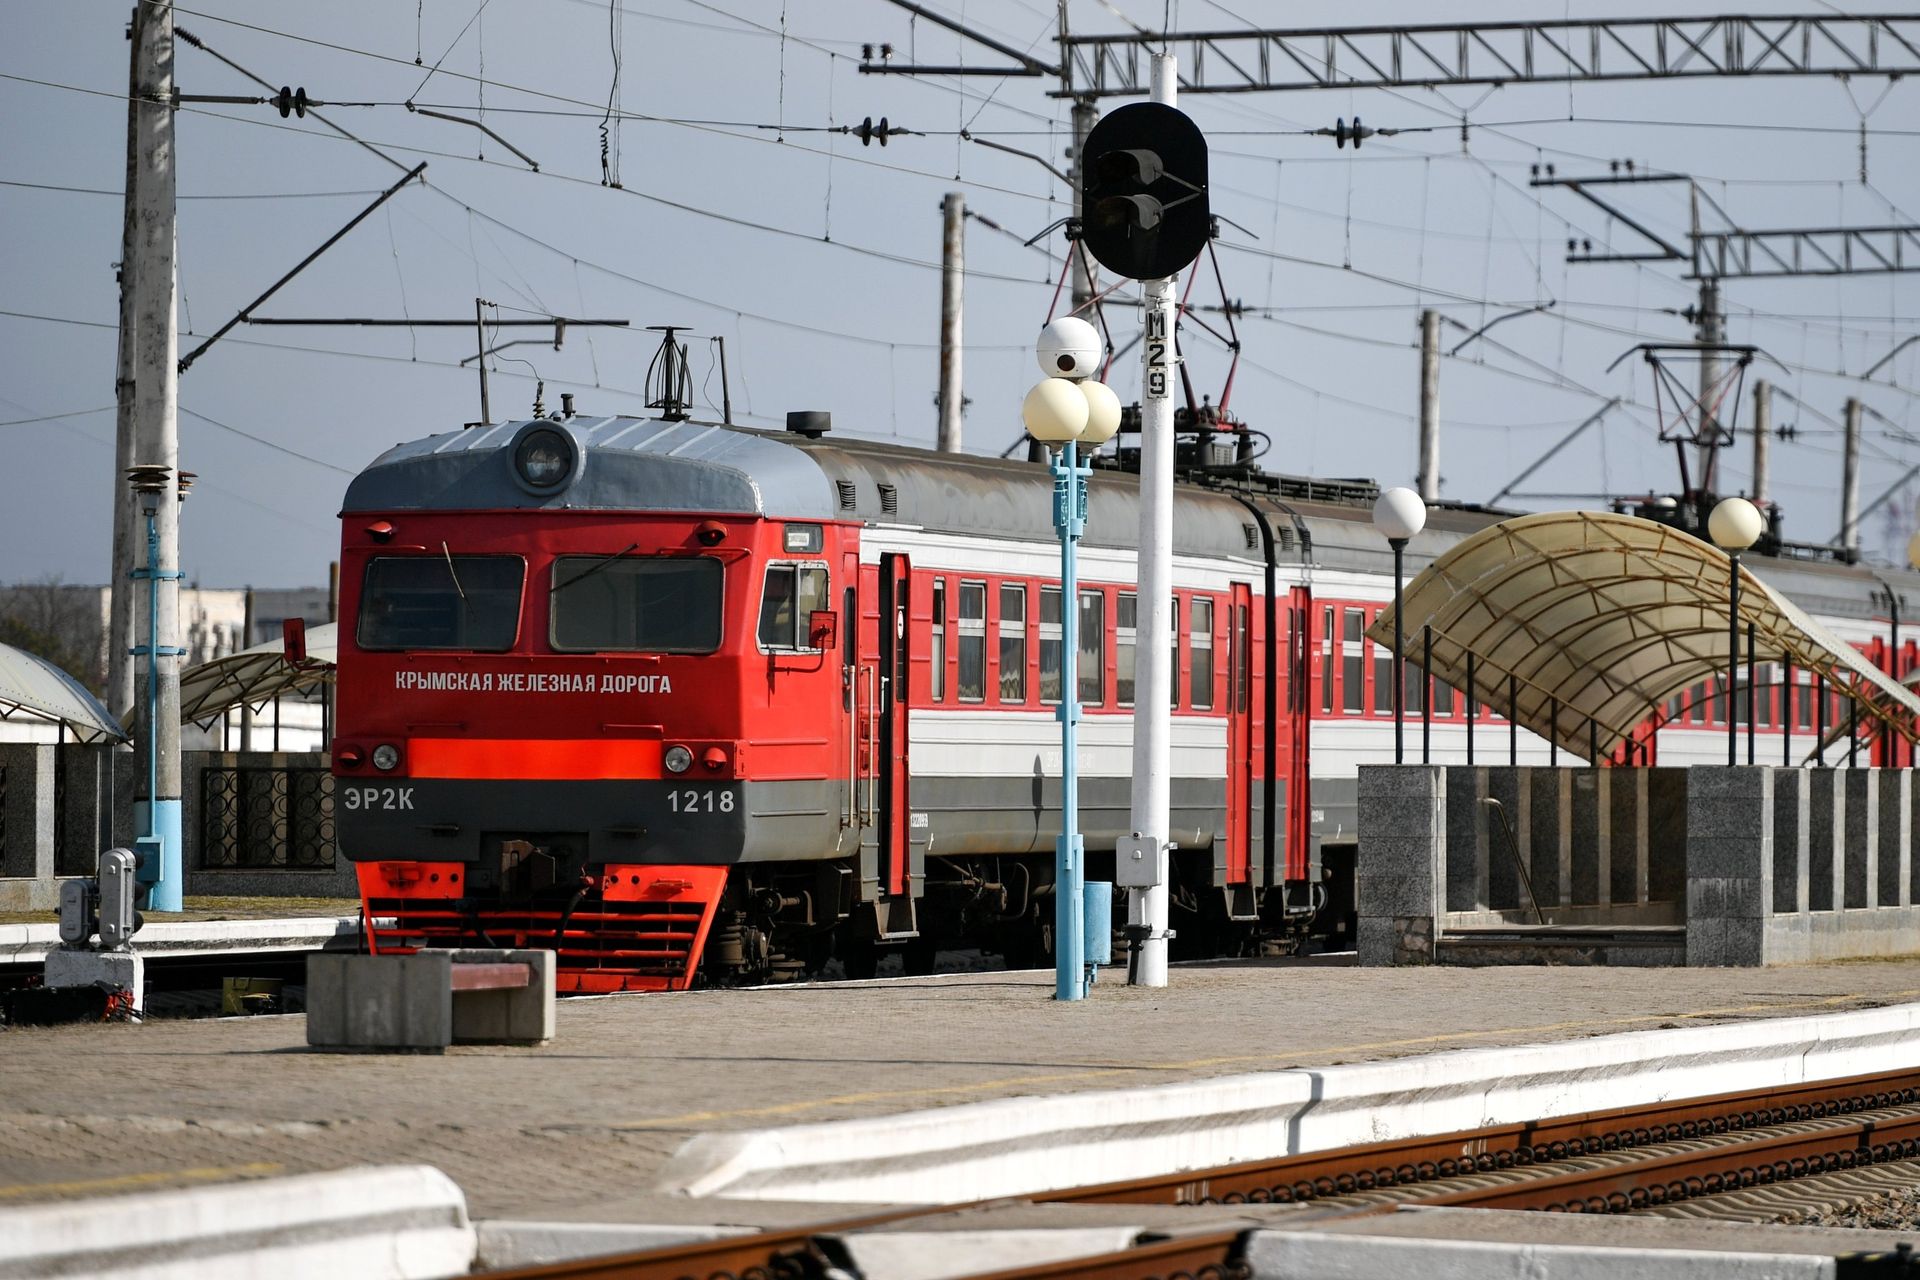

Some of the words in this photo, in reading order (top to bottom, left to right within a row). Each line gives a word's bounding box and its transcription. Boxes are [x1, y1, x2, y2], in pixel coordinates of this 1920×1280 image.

[395, 671, 493, 691] КРЫМСКАЯ
[497, 673, 596, 693] ЖЕЛЕЗНАЯ
[600, 675, 672, 694] ДОРОГА
[344, 787, 414, 810] ЭР2К
[667, 790, 734, 812] 1218
